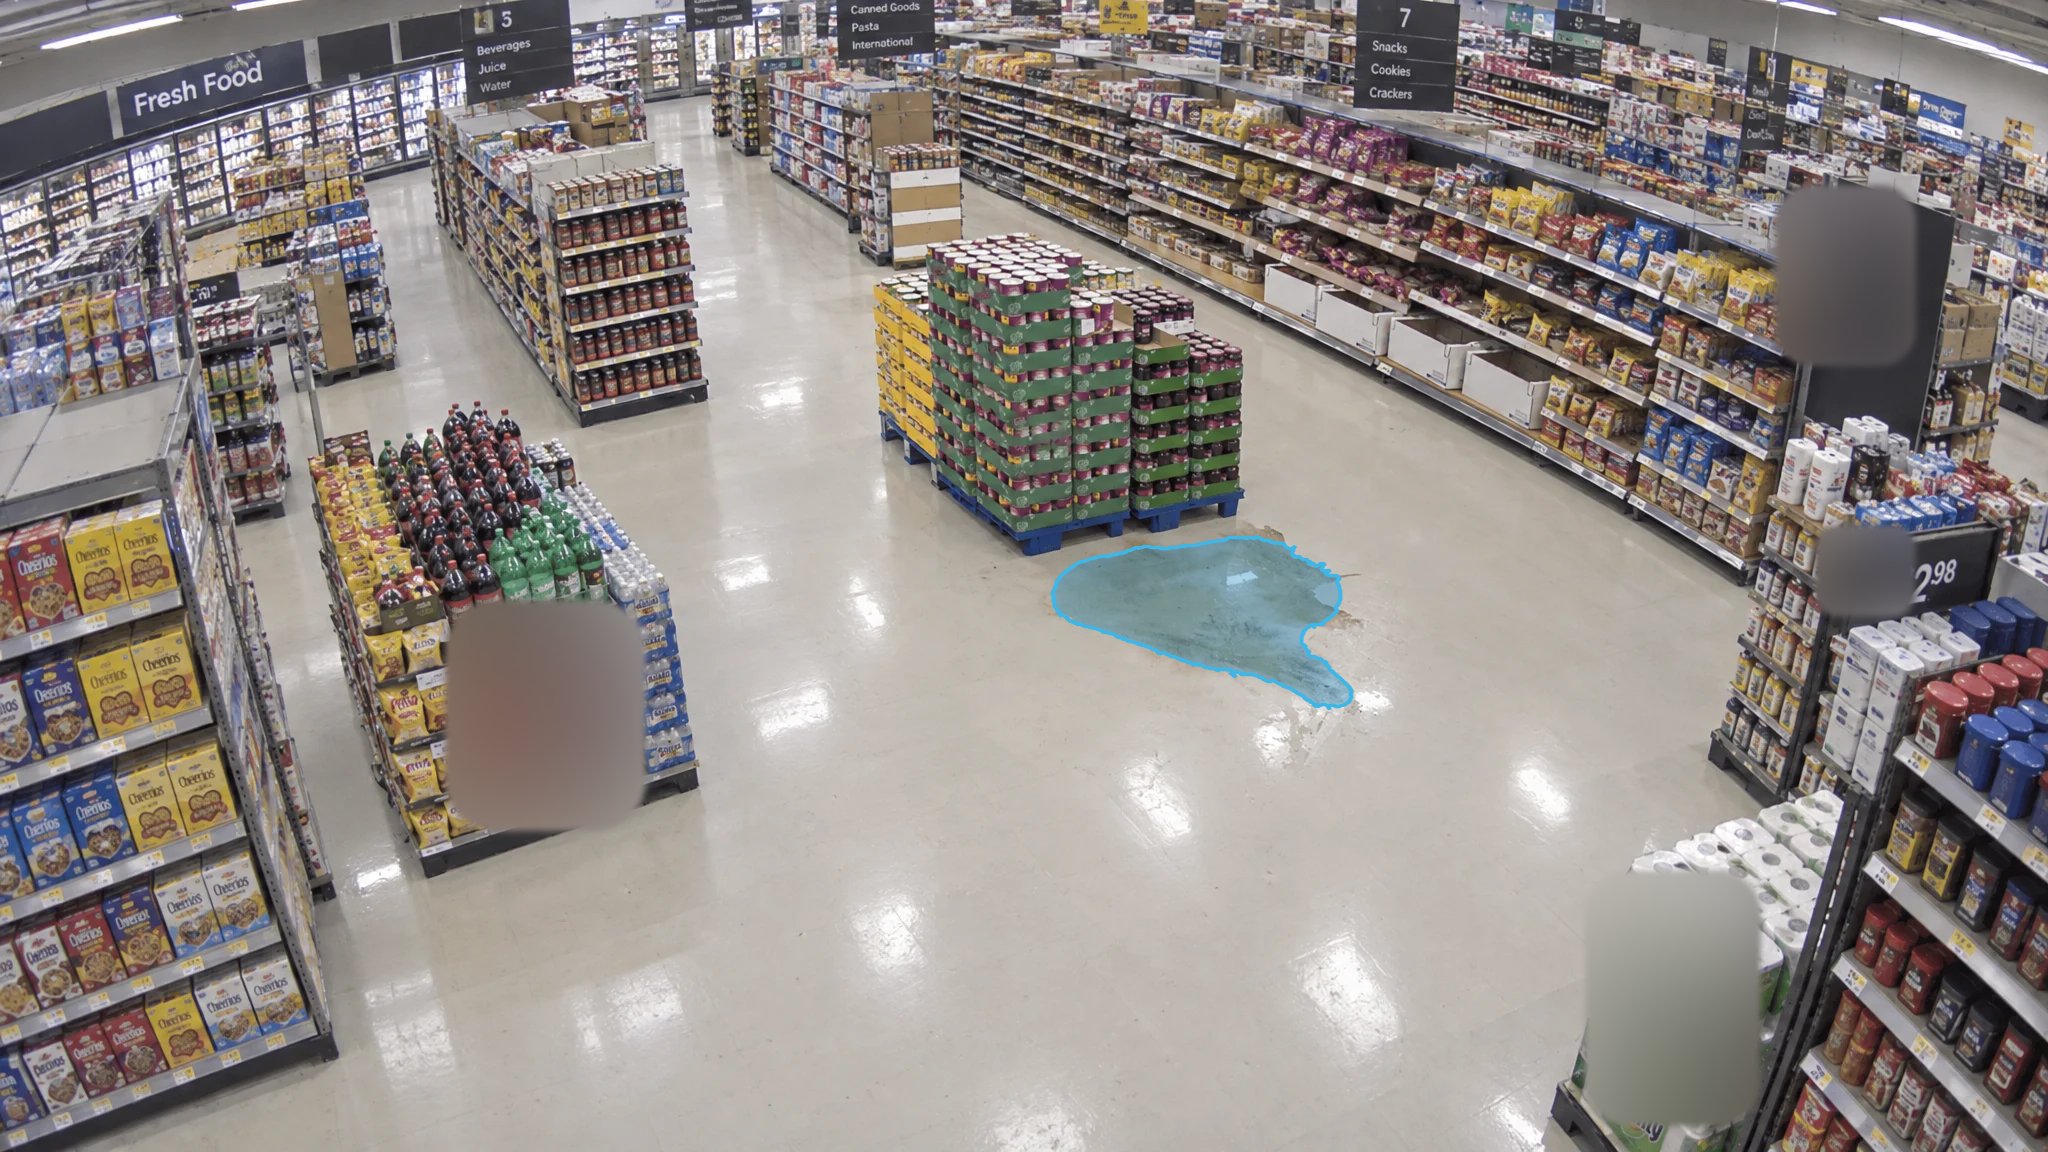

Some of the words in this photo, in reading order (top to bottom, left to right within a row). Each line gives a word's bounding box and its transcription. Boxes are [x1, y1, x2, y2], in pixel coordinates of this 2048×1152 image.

[850, 4, 888, 15] Canned
[889, 2, 921, 12] Goods
[501, 10, 512, 28] 5
[1399, 7, 1412, 28] 7
[851, 22, 880, 33] Pasta
[476, 39, 532, 56] Beverages
[852, 36, 914, 50] International
[1372, 40, 1408, 54] Snacks
[478, 61, 507, 75] Juice
[1370, 63, 1412, 77] Cookies
[134, 80, 198, 117] Fresh
[203, 60, 263, 96] Food
[479, 80, 512, 93] Water
[1369, 86, 1413, 100] Crackers
